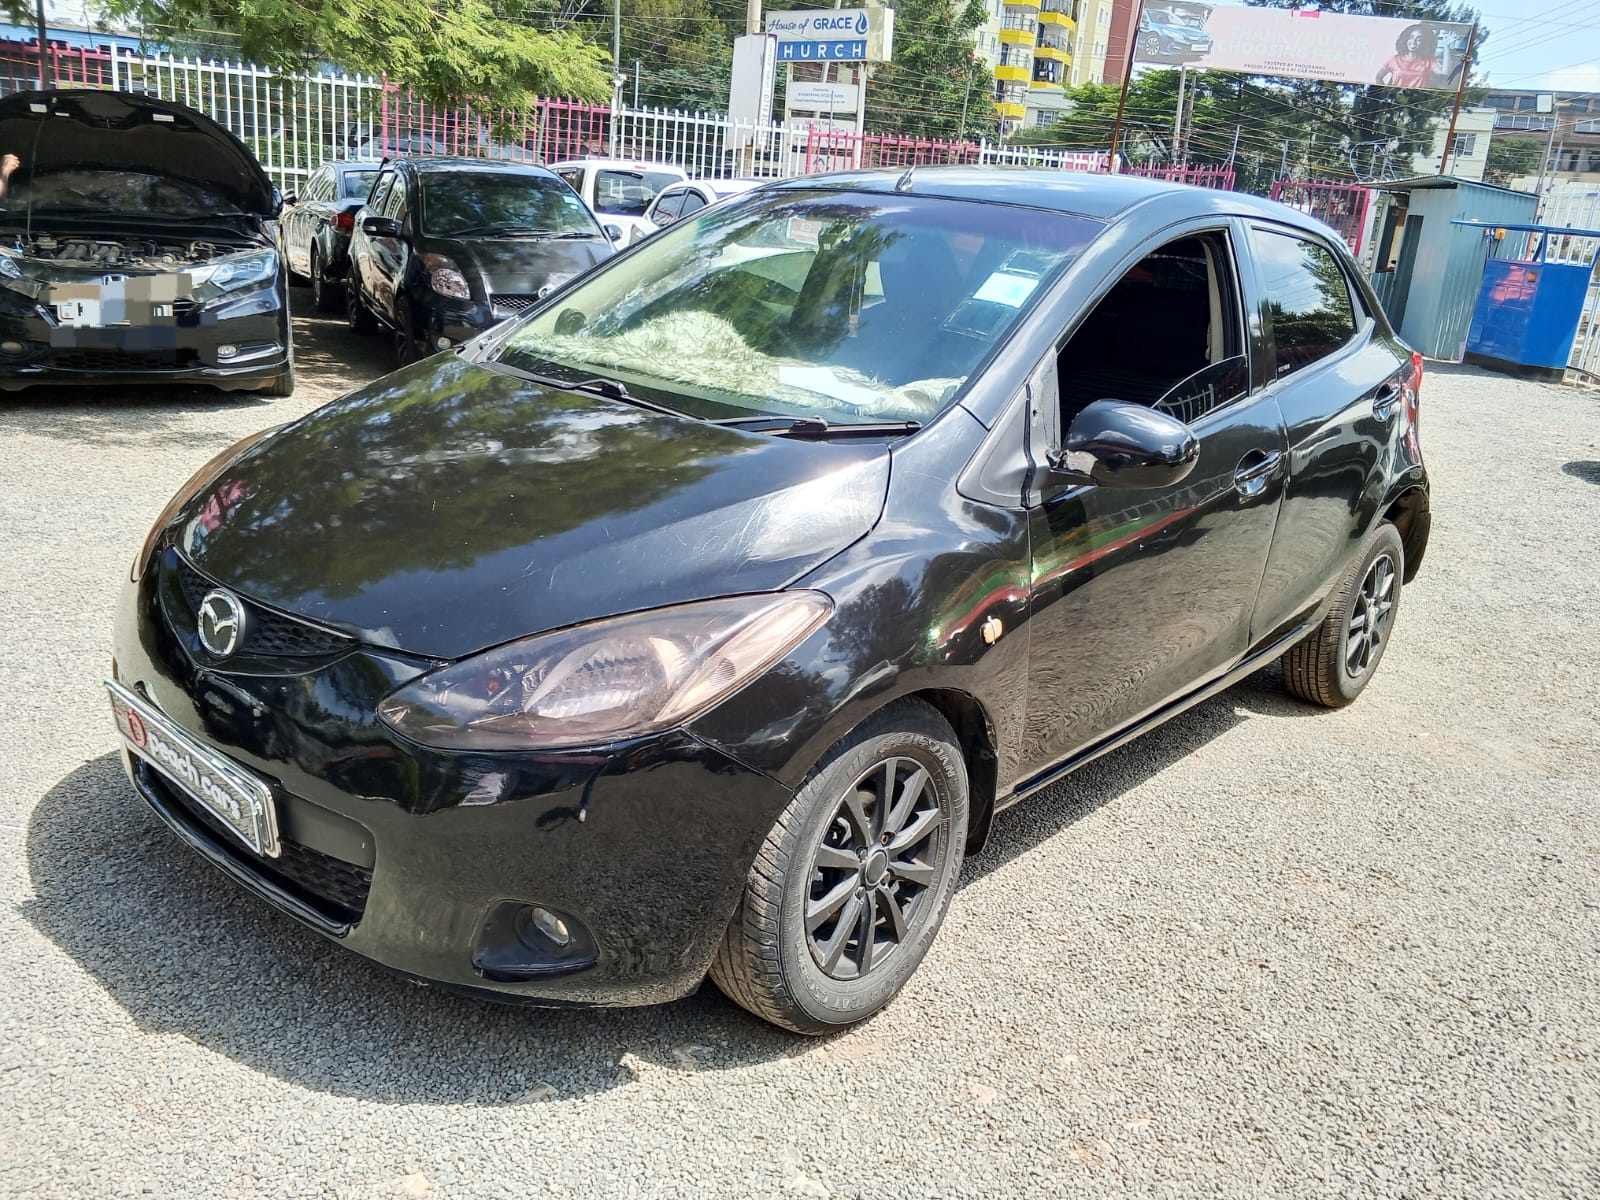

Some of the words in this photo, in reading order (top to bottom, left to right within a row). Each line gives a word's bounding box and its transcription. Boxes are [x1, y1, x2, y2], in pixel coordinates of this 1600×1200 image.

[767, 19, 797, 32] House
[798, 18, 810, 34] of
[813, 17, 853, 30] GRACE
[1231, 26, 1289, 44] THANK
[1295, 31, 1328, 47] YOU
[1334, 35, 1368, 50] FOR
[783, 43, 862, 58] HURCH
[1218, 40, 1308, 59] CHOOSING
[201, 775, 242, 820] cars
